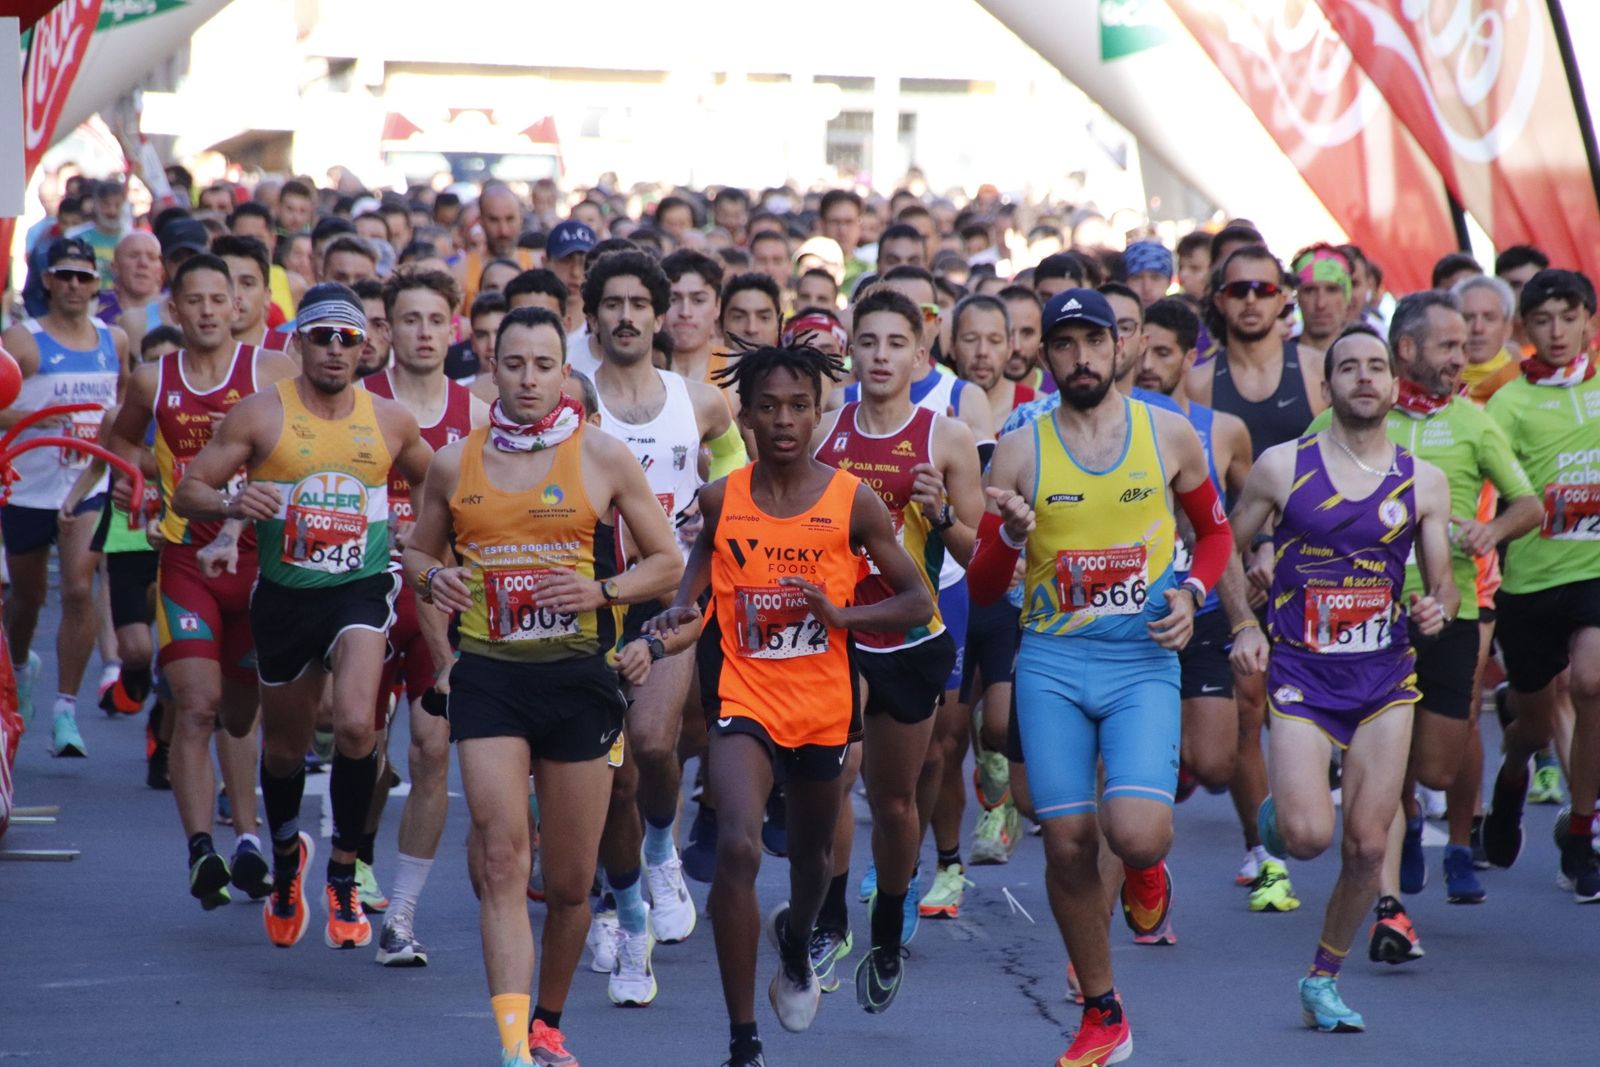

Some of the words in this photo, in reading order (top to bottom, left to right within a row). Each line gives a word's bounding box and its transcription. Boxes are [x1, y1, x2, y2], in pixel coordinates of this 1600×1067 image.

[875, 463, 900, 473] RURAL
[810, 517, 832, 525] FMD
[484, 546, 518, 555] ESTER
[764, 547, 824, 562] VICKY
[768, 563, 817, 575] FOODS
